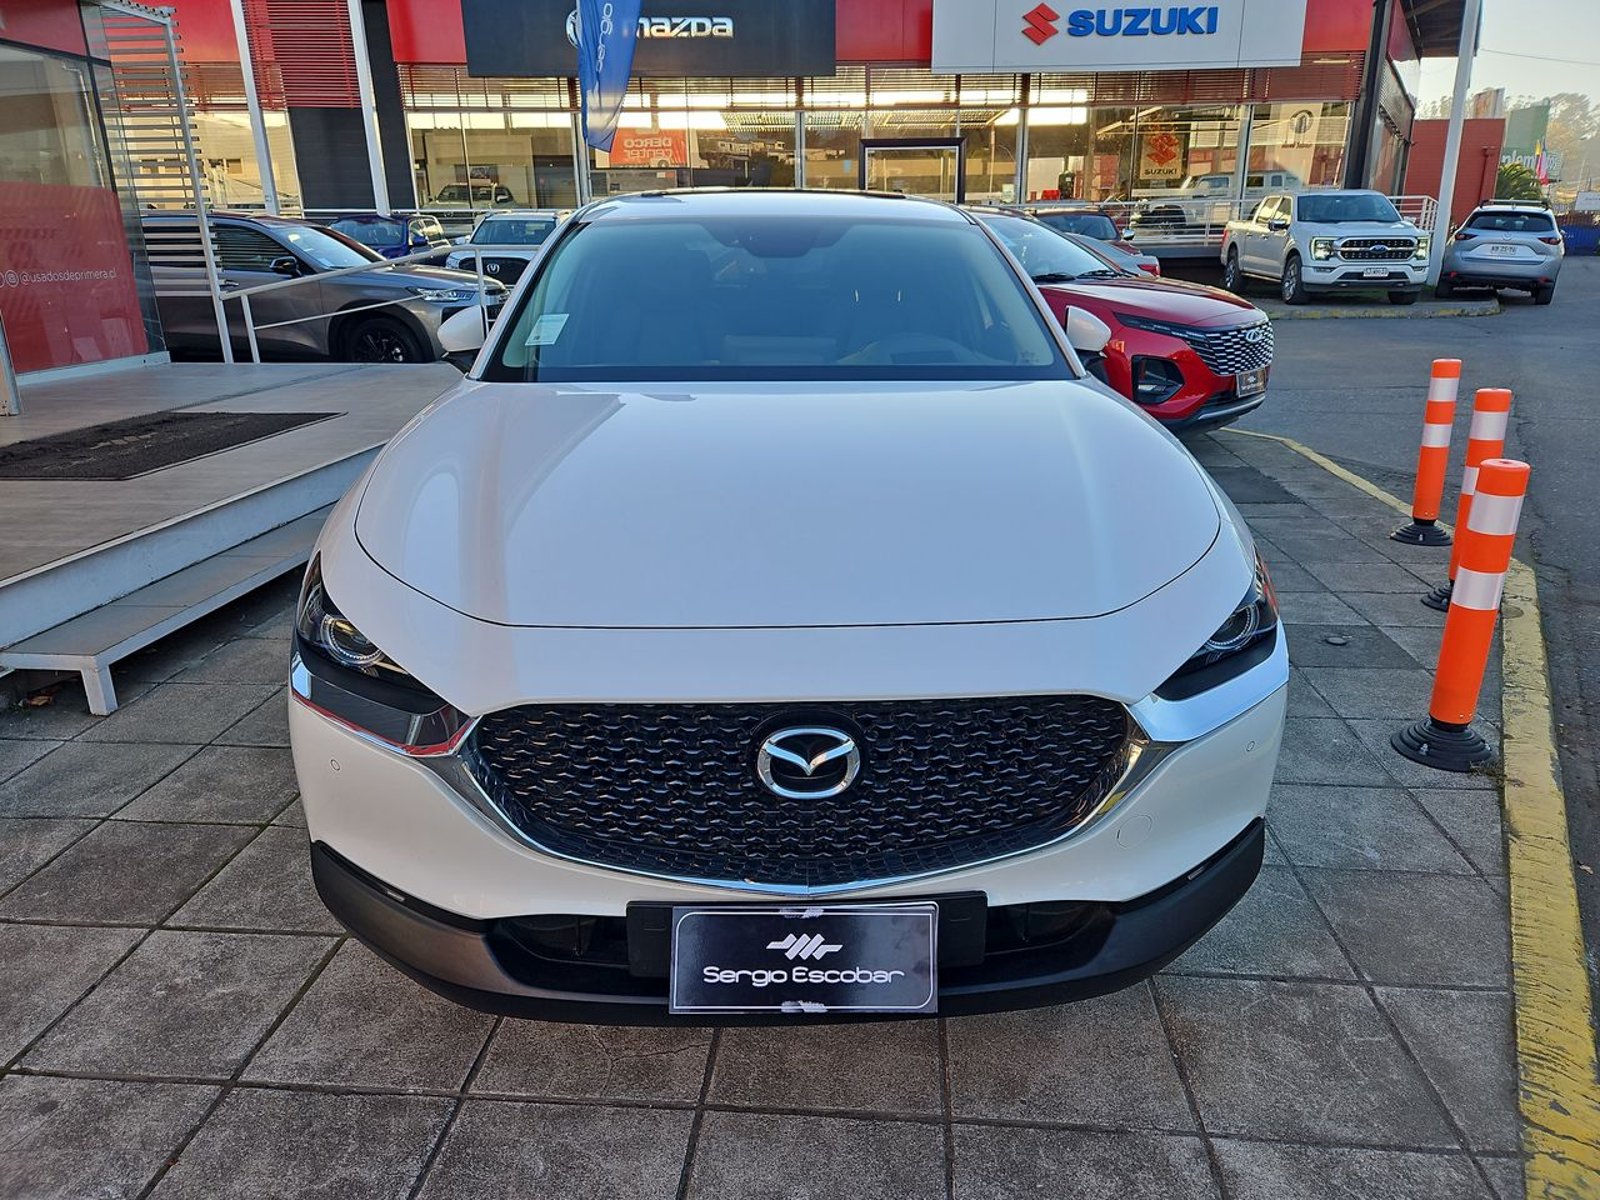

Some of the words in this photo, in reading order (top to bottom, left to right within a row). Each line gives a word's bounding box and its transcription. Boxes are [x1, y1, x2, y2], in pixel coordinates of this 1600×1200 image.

[1067, 7, 1218, 37] SUZUKI
[1144, 168, 1177, 176] SUZUKI
[703, 967, 788, 987] Sergio
[792, 967, 905, 983] Escobar
